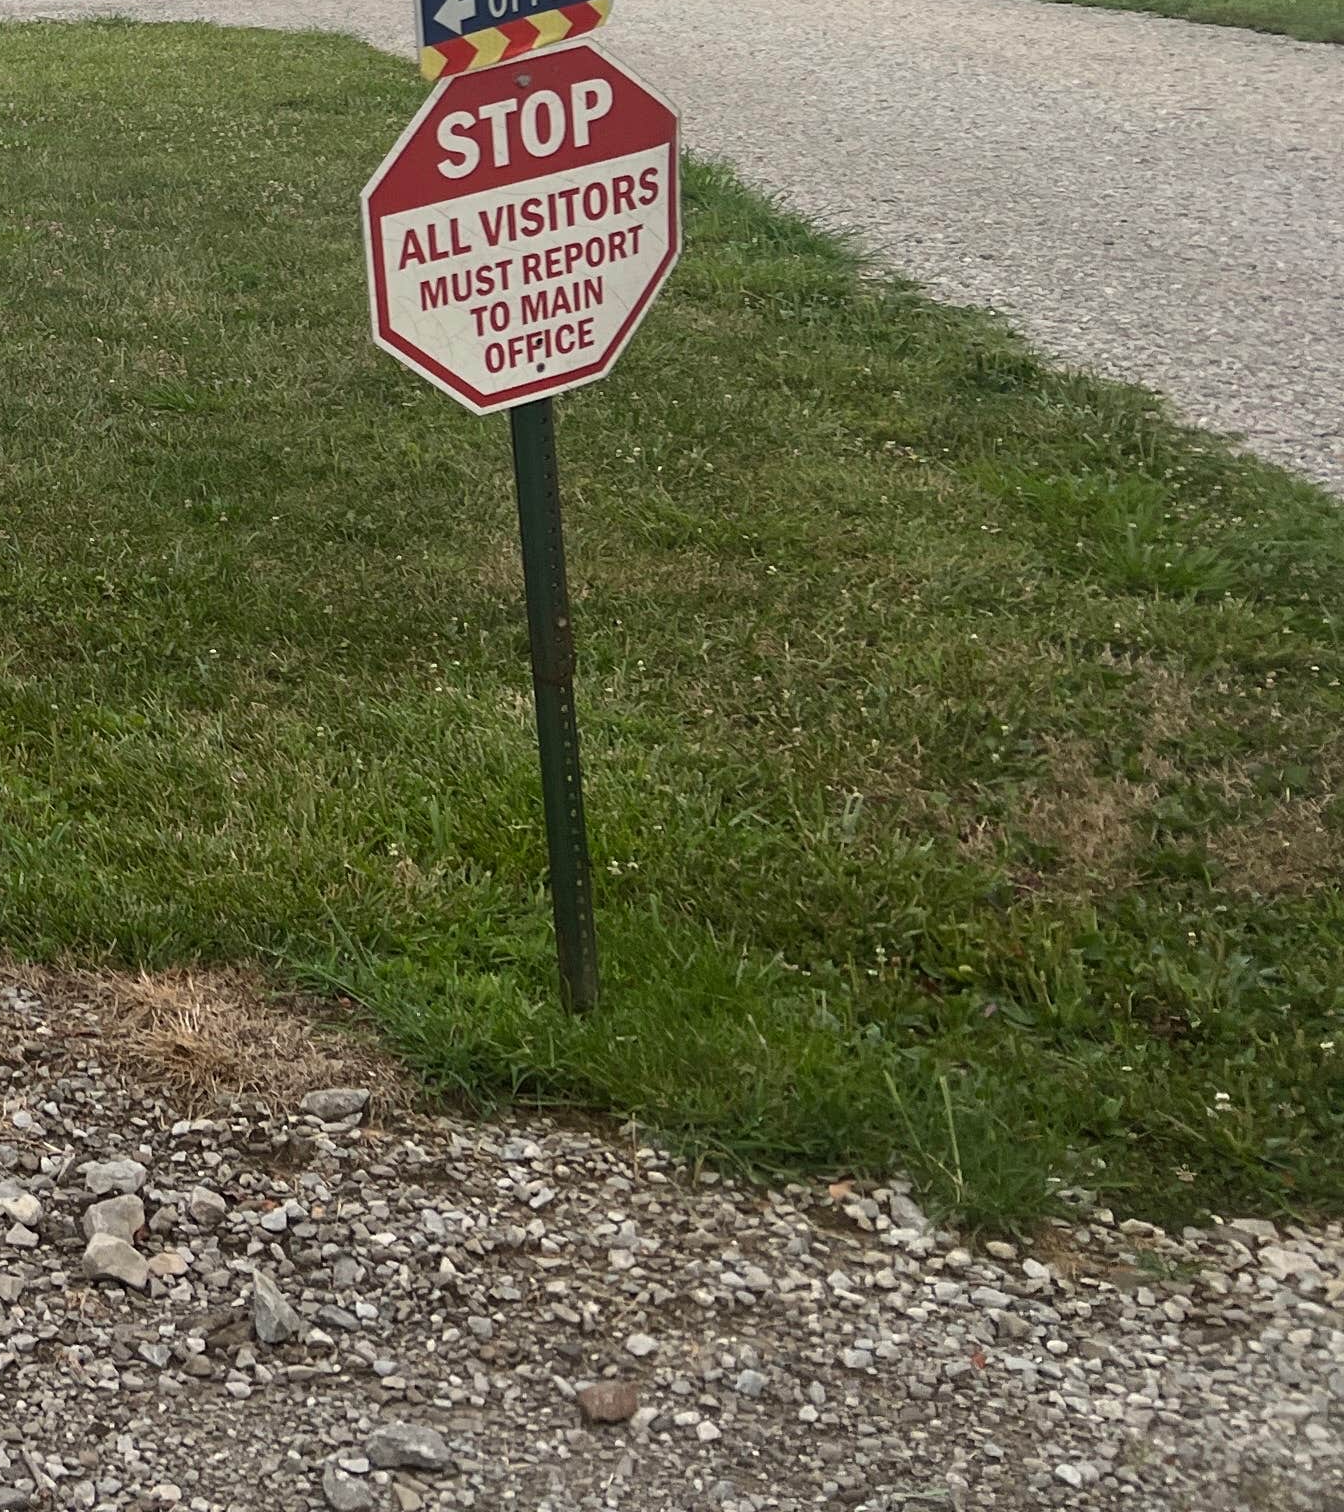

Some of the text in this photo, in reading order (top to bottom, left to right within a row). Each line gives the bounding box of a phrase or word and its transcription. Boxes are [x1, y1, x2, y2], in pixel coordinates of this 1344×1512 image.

[436, 77, 614, 180] STOP
[398, 166, 660, 271] ALL VISITORS
[420, 224, 644, 311] MUST REPORT
[470, 275, 605, 337] TO MAIN
[484, 317, 596, 374] OFFICE
